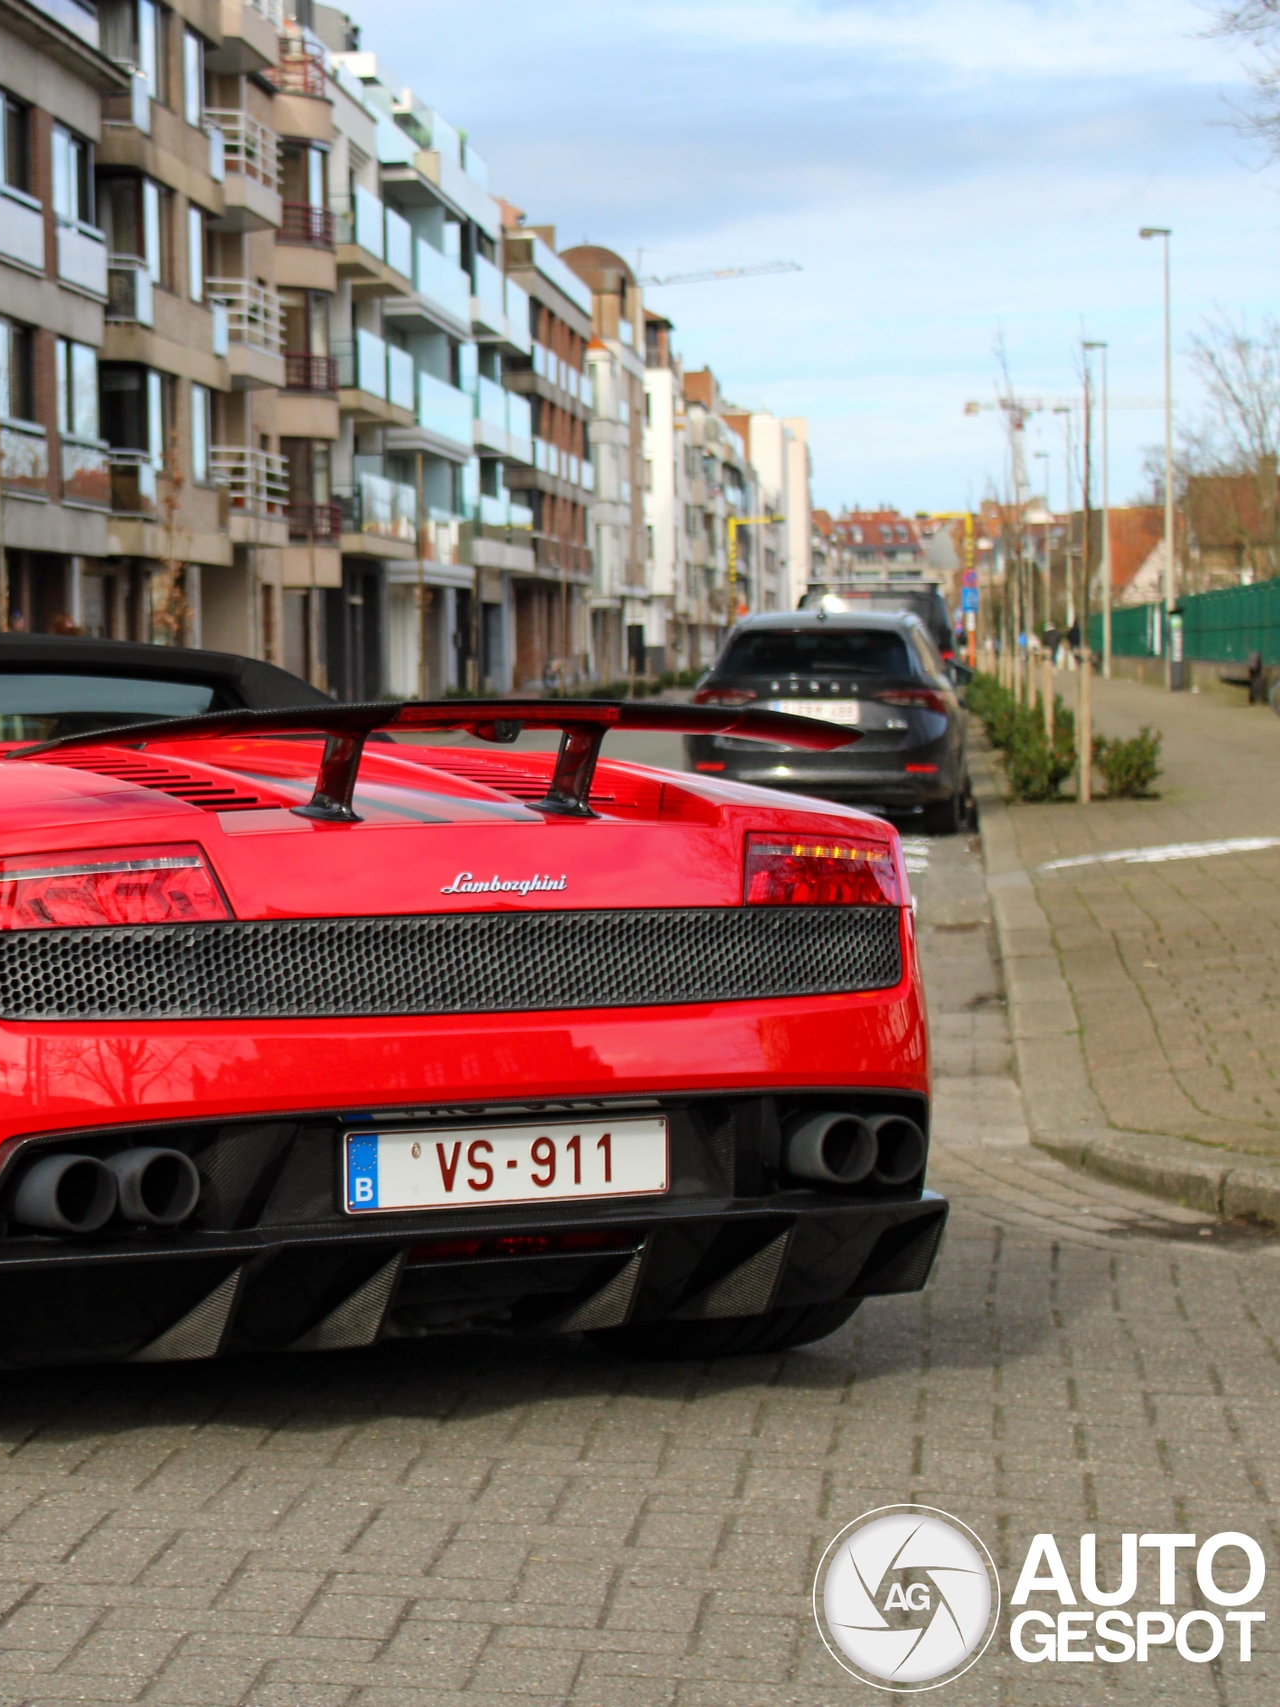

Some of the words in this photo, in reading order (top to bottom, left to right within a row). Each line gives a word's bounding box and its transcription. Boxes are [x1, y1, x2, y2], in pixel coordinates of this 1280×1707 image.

[440, 871, 568, 896] Lamborghini
[435, 1133, 612, 1193] VS-911
[355, 1177, 374, 1202] B
